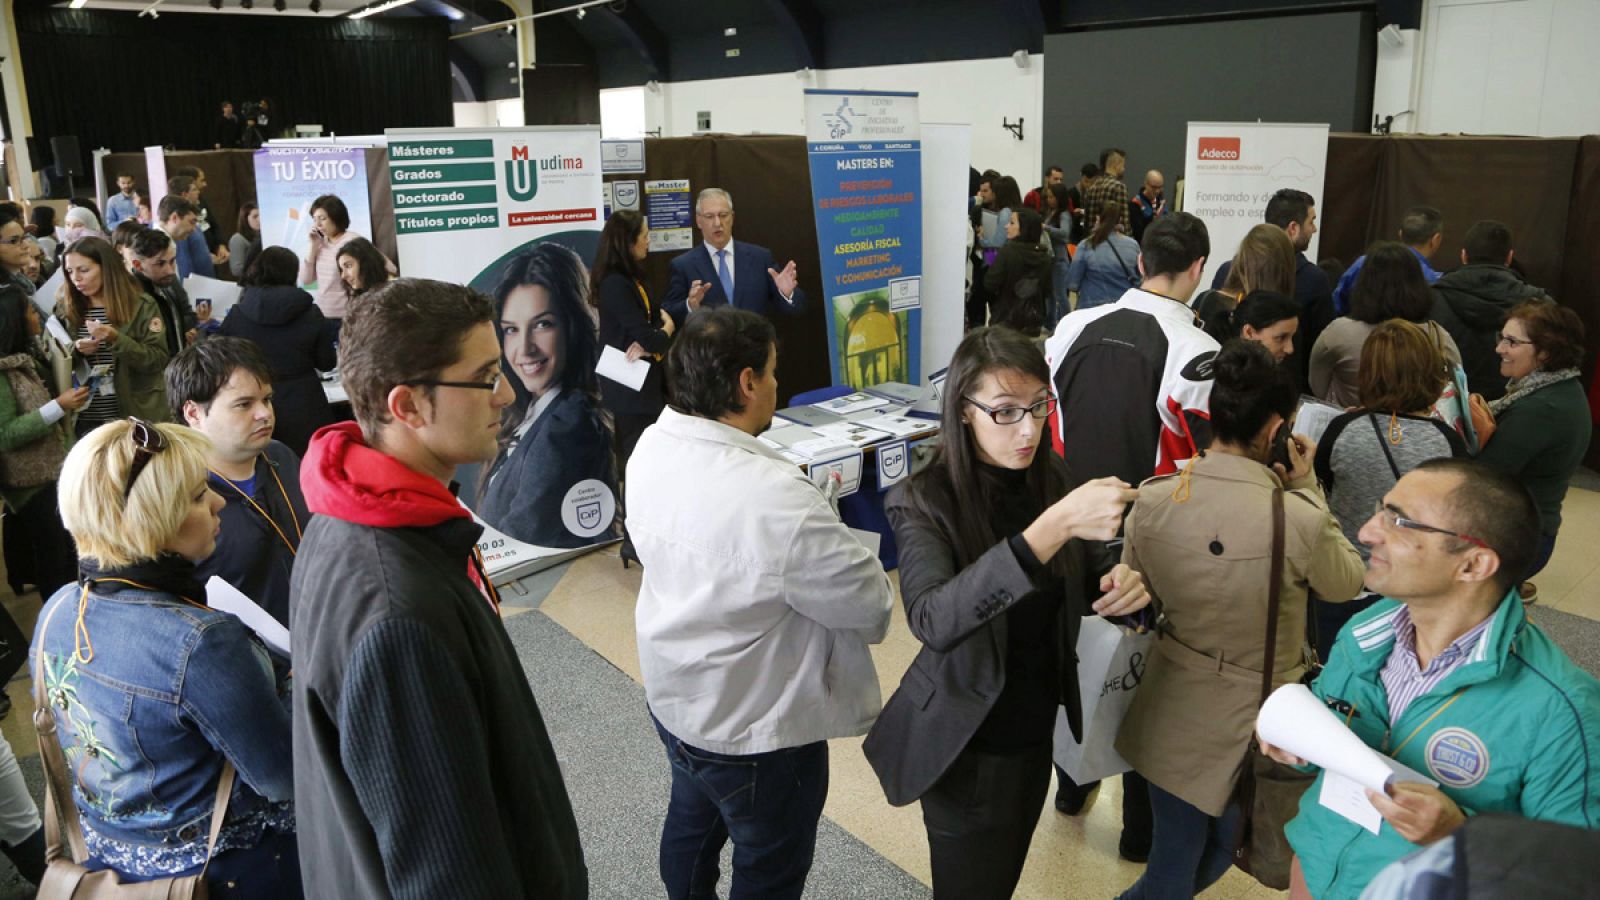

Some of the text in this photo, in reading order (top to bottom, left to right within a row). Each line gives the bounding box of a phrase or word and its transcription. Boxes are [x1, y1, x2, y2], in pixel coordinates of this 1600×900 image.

[392, 144, 455, 157] Másteres
[1200, 148, 1237, 159] Adecco
[271, 156, 355, 181] TU ÉXITO
[540, 154, 583, 170] udima
[836, 157, 894, 170] MASTERS EN:
[394, 169, 442, 181] Grados
[396, 191, 465, 204] Doctorado
[1196, 191, 1250, 202] Formando
[1252, 194, 1259, 204] y
[523, 214, 563, 222] universidad
[1196, 208, 1265, 219] empleo a esp
[398, 213, 496, 229] Títulos propios
[851, 224, 885, 237] CALIDAD
[834, 237, 901, 254] ASESORÍA FISCAL
[846, 253, 890, 268] MARKETING
[835, 266, 902, 285] Y COMUNICACIÓN
[492, 539, 505, 549] 03
